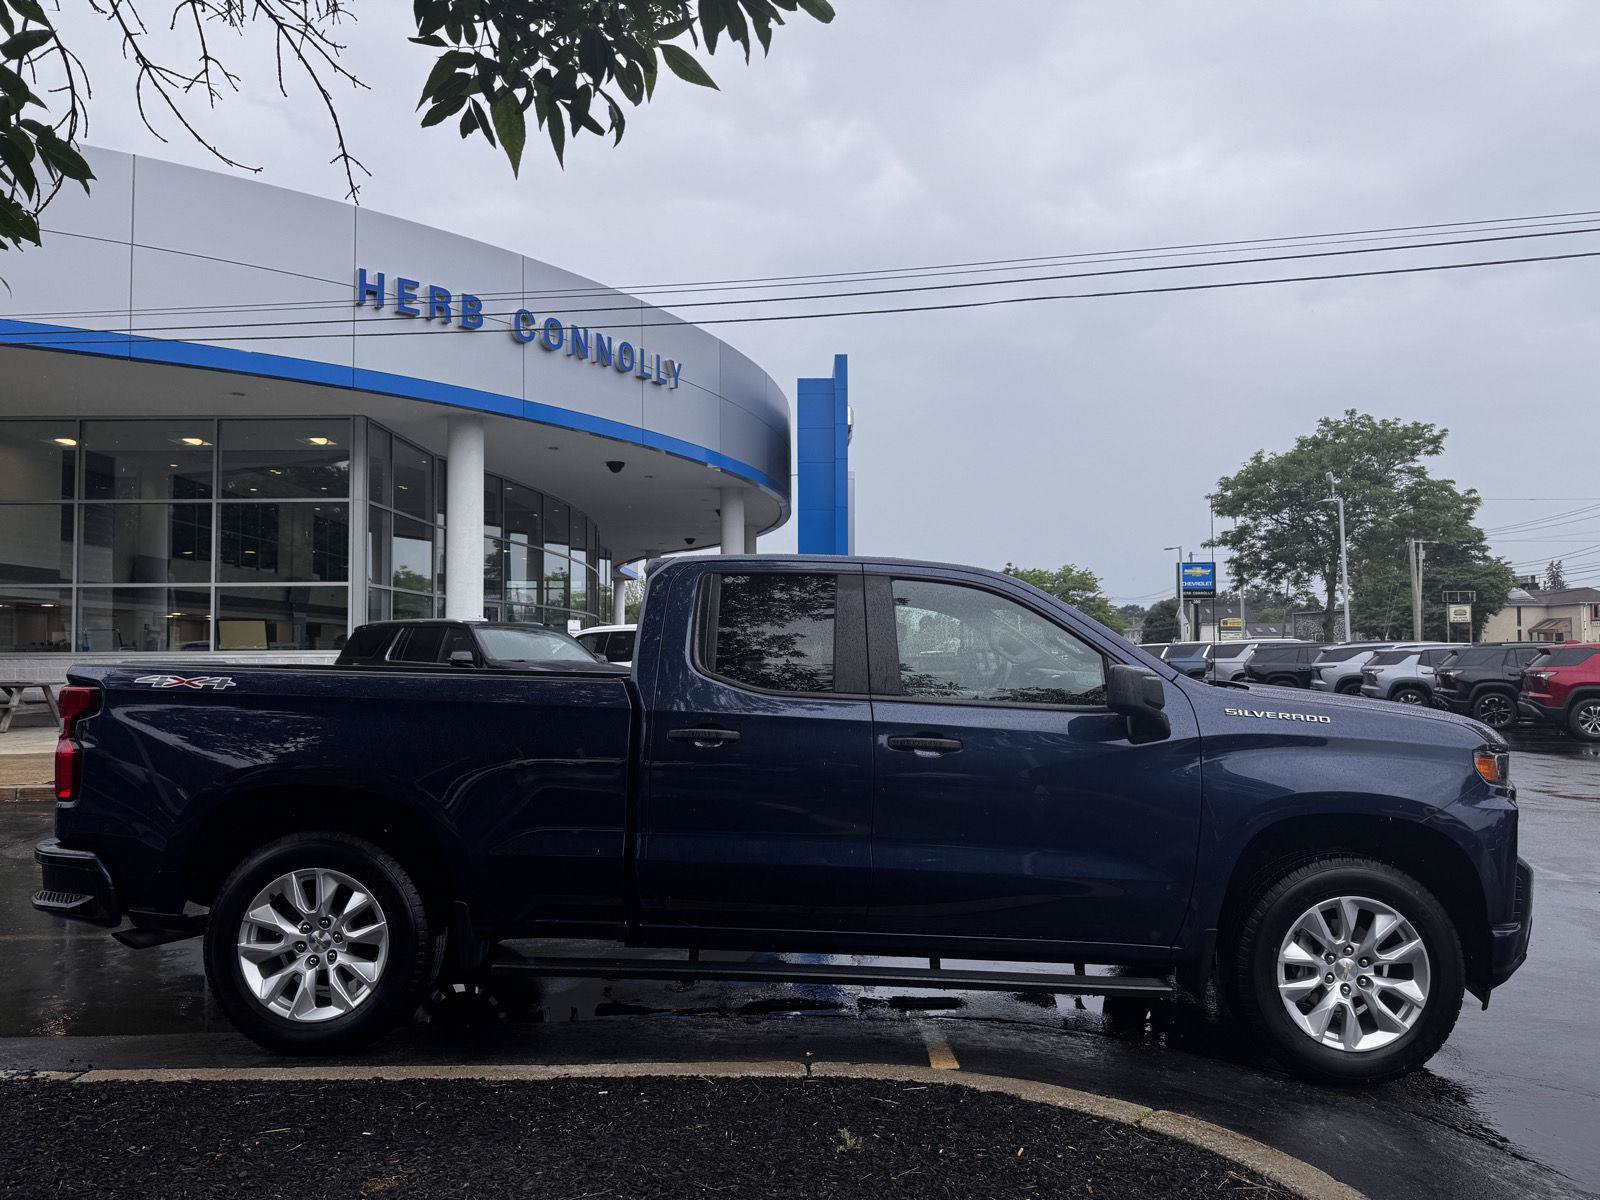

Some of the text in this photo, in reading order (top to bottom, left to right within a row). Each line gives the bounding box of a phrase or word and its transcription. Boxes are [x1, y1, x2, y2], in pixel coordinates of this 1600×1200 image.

[356, 268, 682, 390] HERB CONNOLLY
[1224, 708, 1331, 724] SILVERADO
